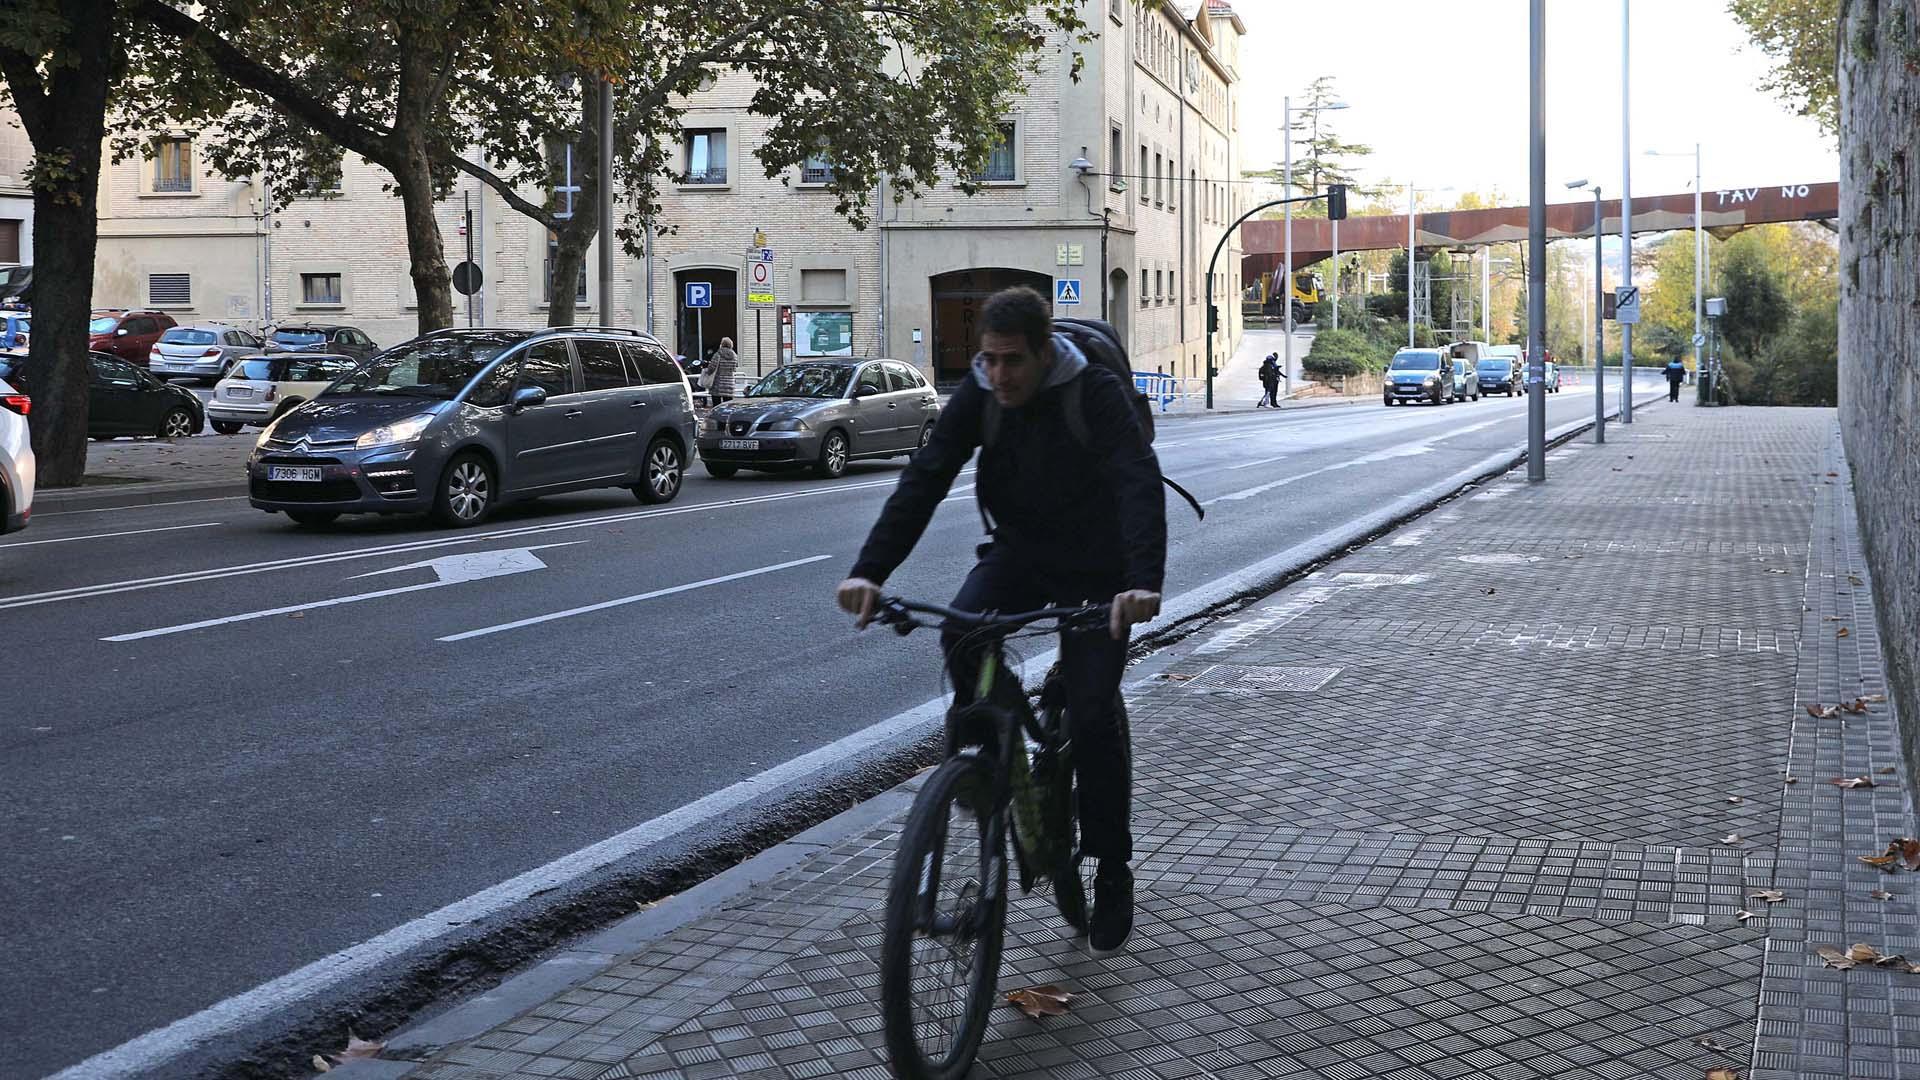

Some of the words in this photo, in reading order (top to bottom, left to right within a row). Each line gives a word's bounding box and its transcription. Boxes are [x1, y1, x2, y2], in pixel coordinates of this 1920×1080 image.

[1716, 188, 1758, 205] TAV
[1782, 185, 1809, 199] NO
[691, 285, 706, 305] P
[274, 467, 297, 479] 7306
